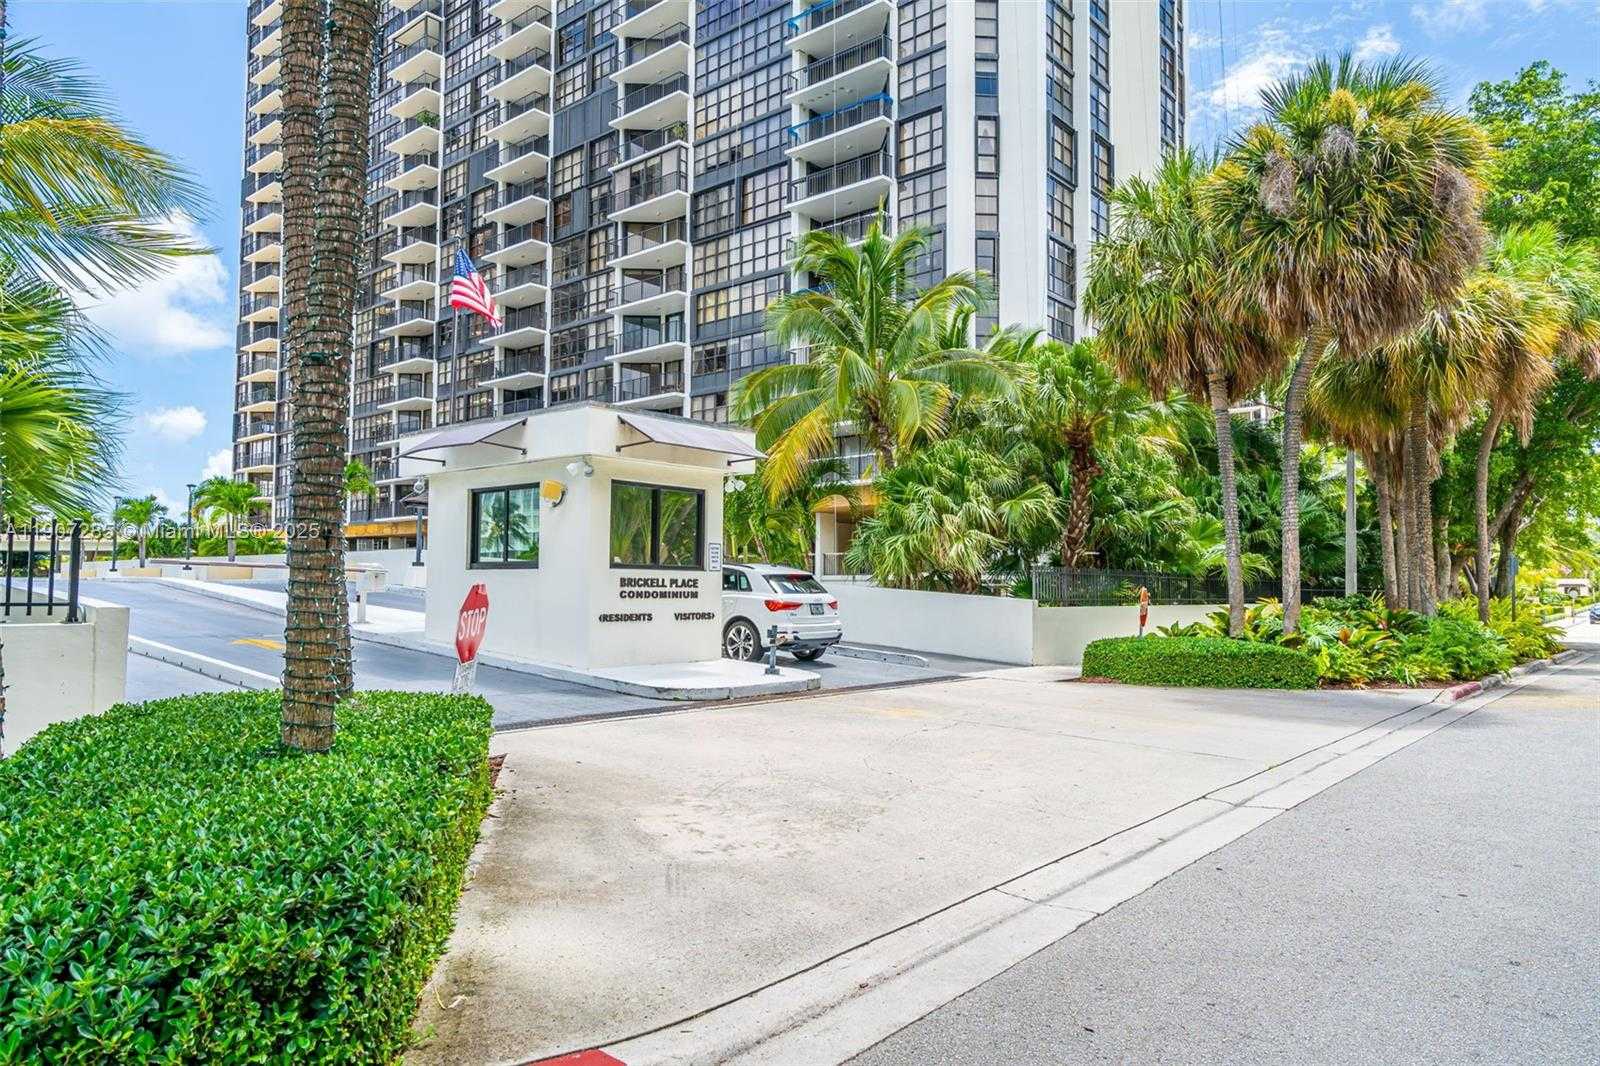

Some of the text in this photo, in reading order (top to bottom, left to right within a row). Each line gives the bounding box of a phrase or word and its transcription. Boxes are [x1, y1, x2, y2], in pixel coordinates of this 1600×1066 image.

[619, 577, 699, 589] BRICKELL PLACE
[619, 590, 699, 599] CONDOMINIUM
[458, 606, 487, 641] STOP
